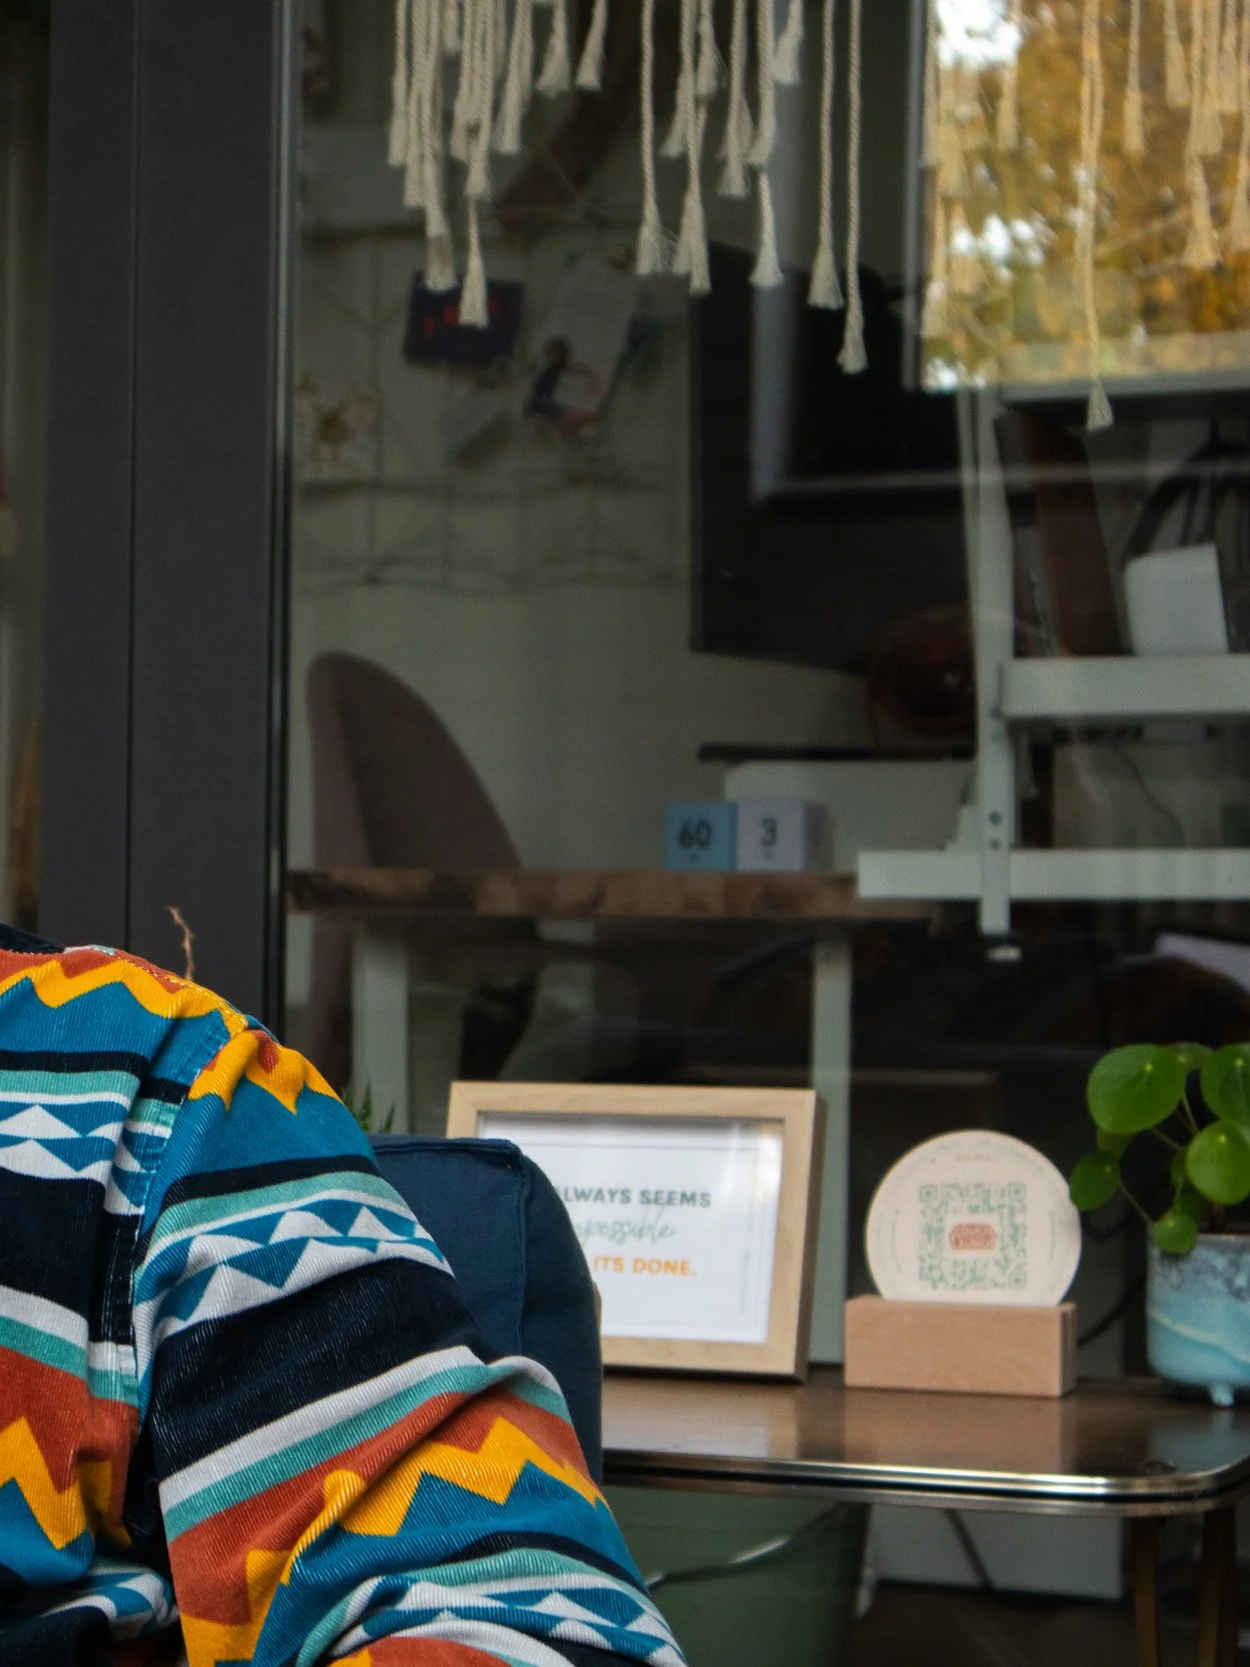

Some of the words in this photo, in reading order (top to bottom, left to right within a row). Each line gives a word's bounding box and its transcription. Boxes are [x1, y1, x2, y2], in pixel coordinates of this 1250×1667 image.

[639, 1189, 712, 1208] SEEMS
[593, 1255, 625, 1273] ITS
[632, 1257, 697, 1277] DONE.
